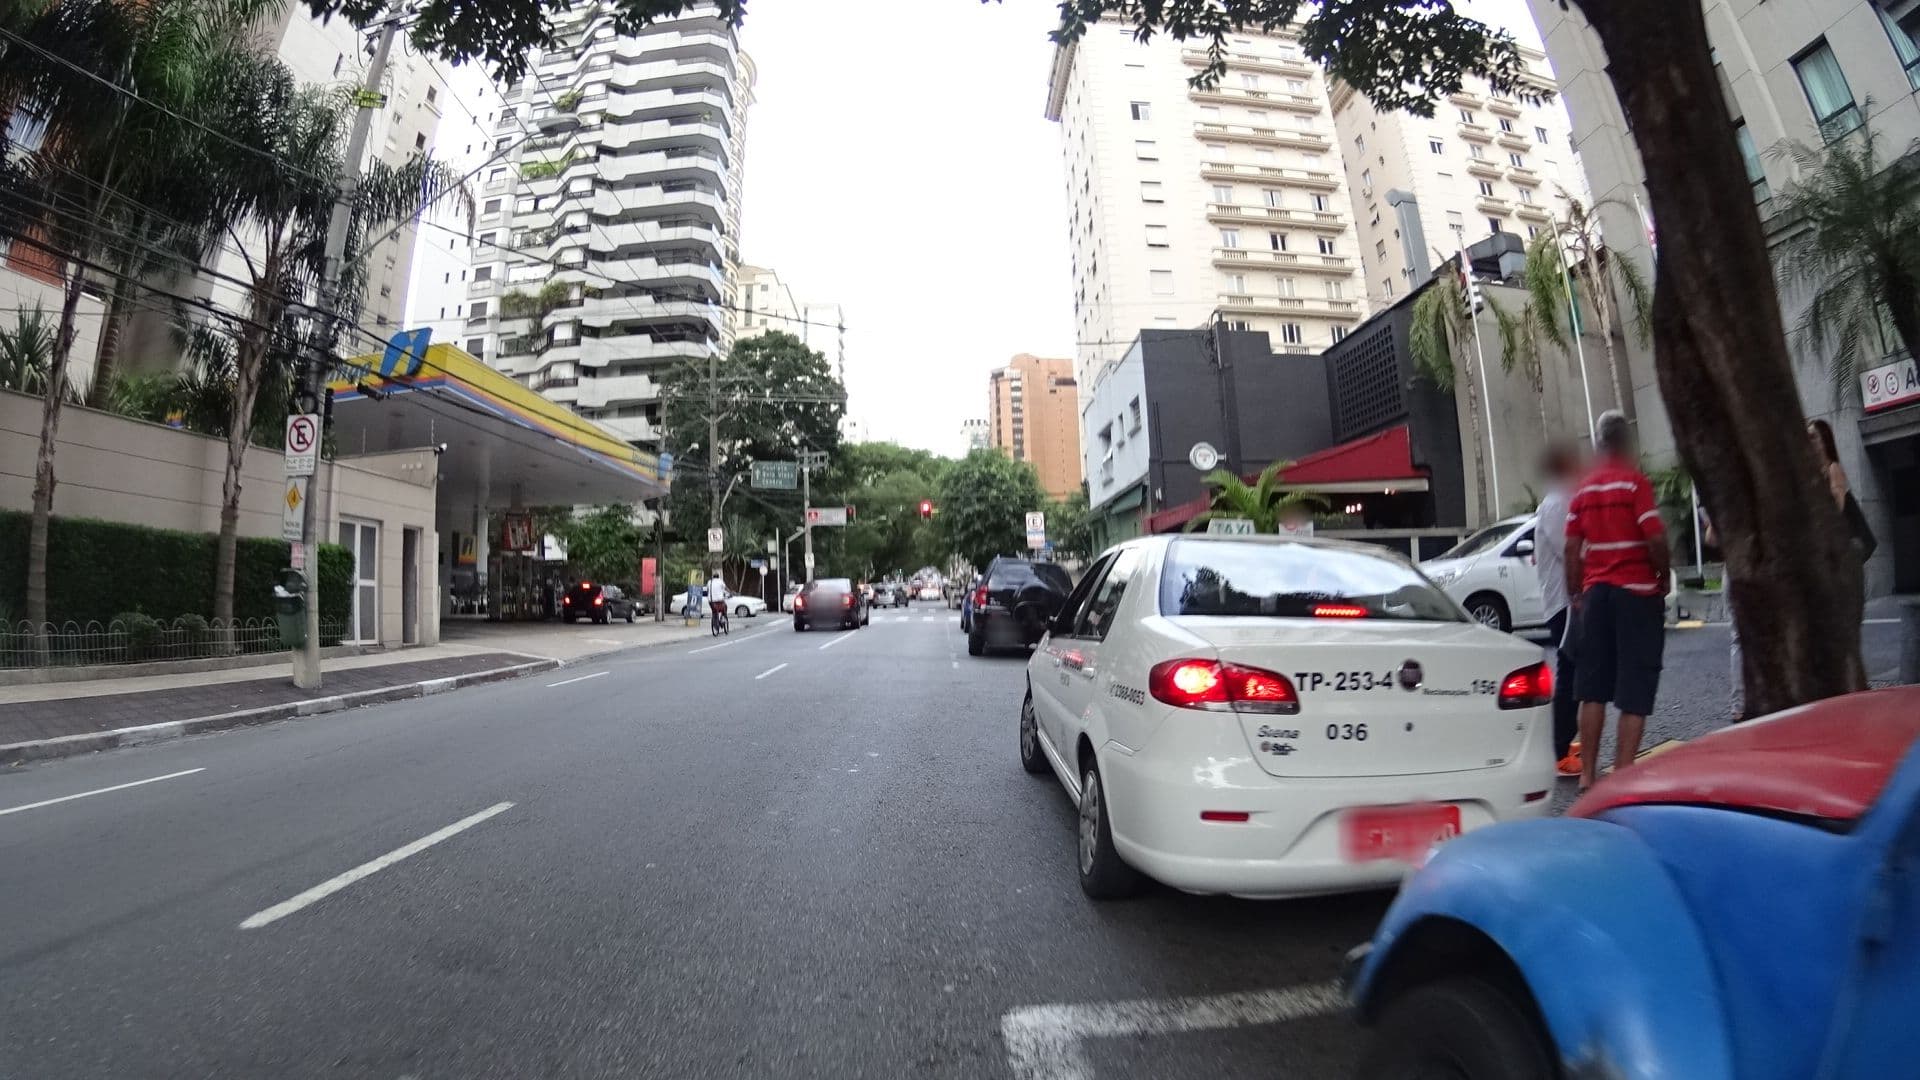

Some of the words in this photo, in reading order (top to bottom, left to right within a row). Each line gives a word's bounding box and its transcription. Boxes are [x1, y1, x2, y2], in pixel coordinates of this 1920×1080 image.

[1215, 523, 1251, 535] TAXI
[1294, 671, 1393, 692] TP-253-4
[1471, 679, 1498, 695] 156
[1326, 723, 1368, 741] 036
